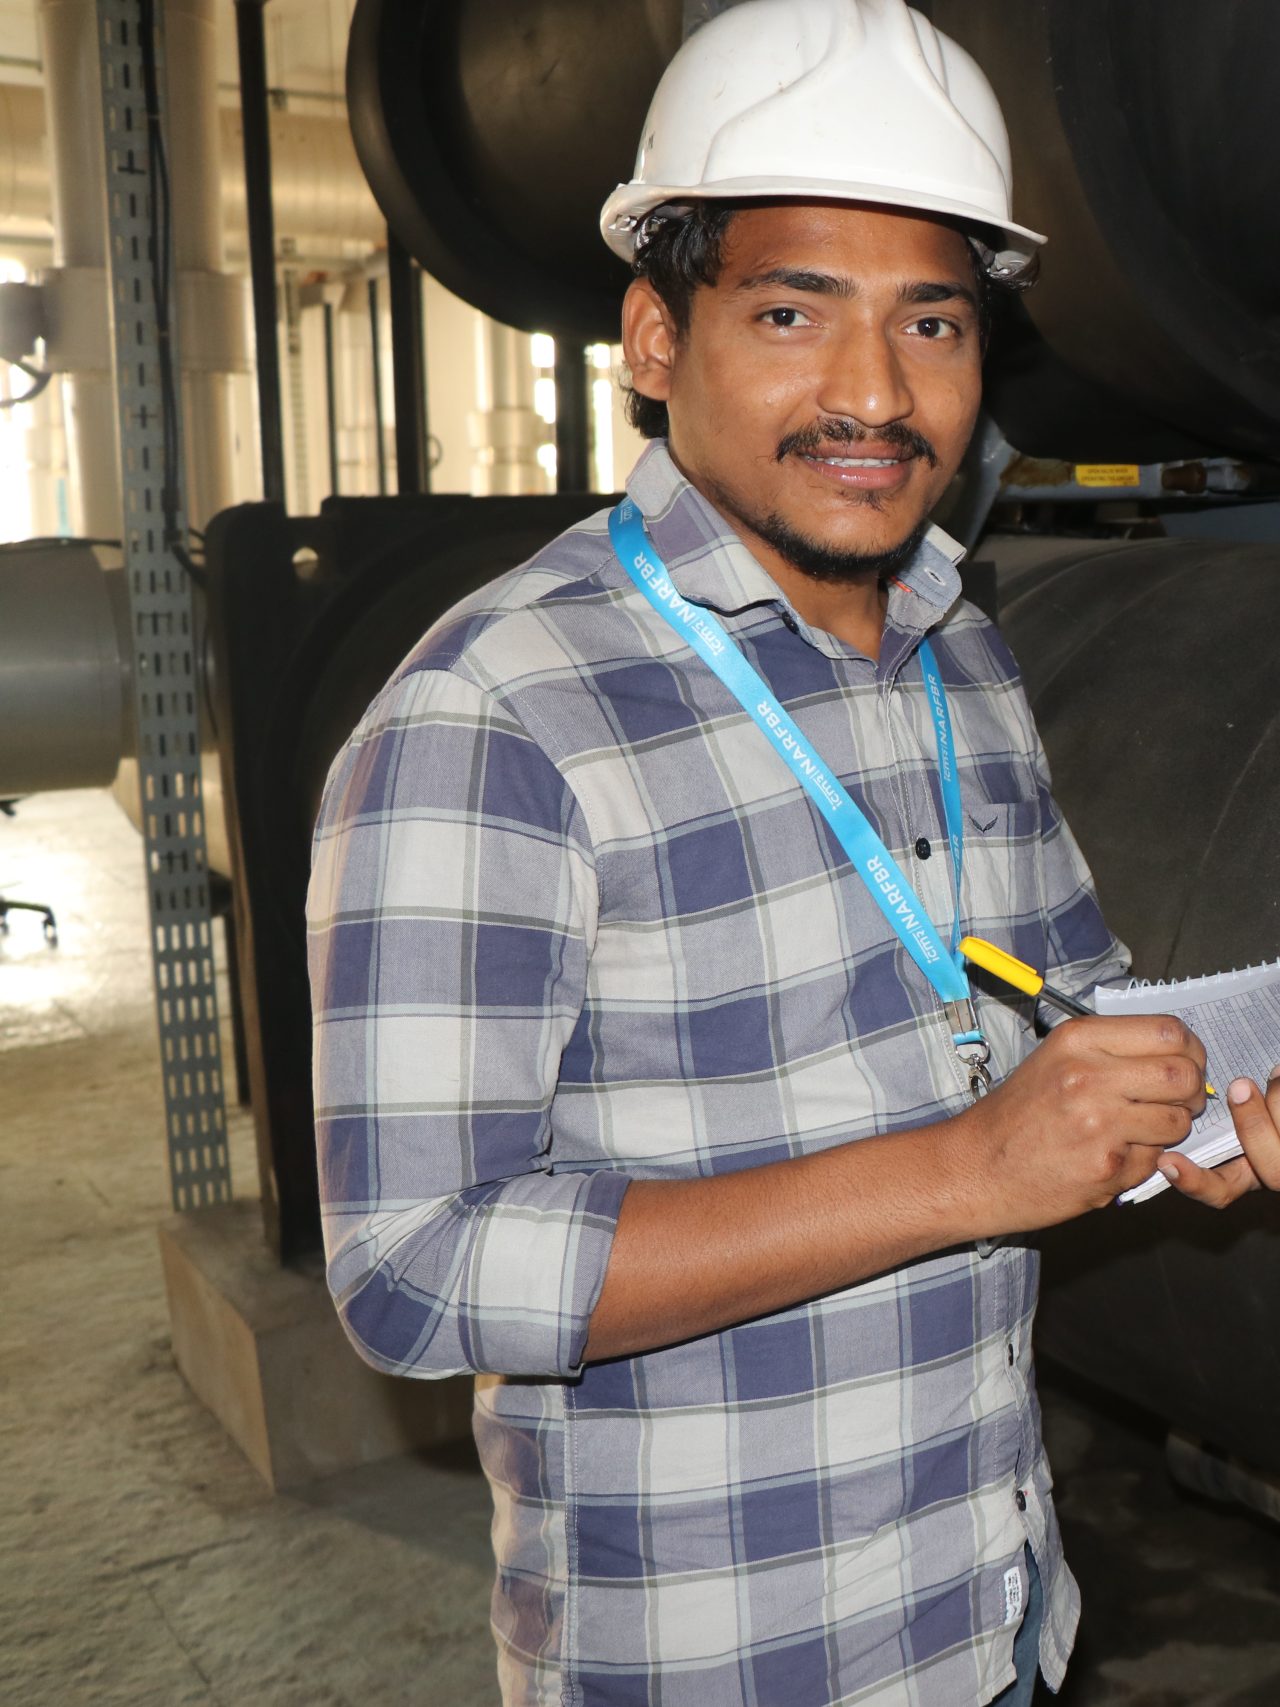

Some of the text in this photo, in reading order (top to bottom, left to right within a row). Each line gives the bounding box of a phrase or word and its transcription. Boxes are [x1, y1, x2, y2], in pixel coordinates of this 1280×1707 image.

[634, 552, 696, 624] NARFBR
[757, 700, 816, 774] NARFBR
[928, 674, 948, 744] NARFBR
[866, 855, 920, 930] NARFBR
